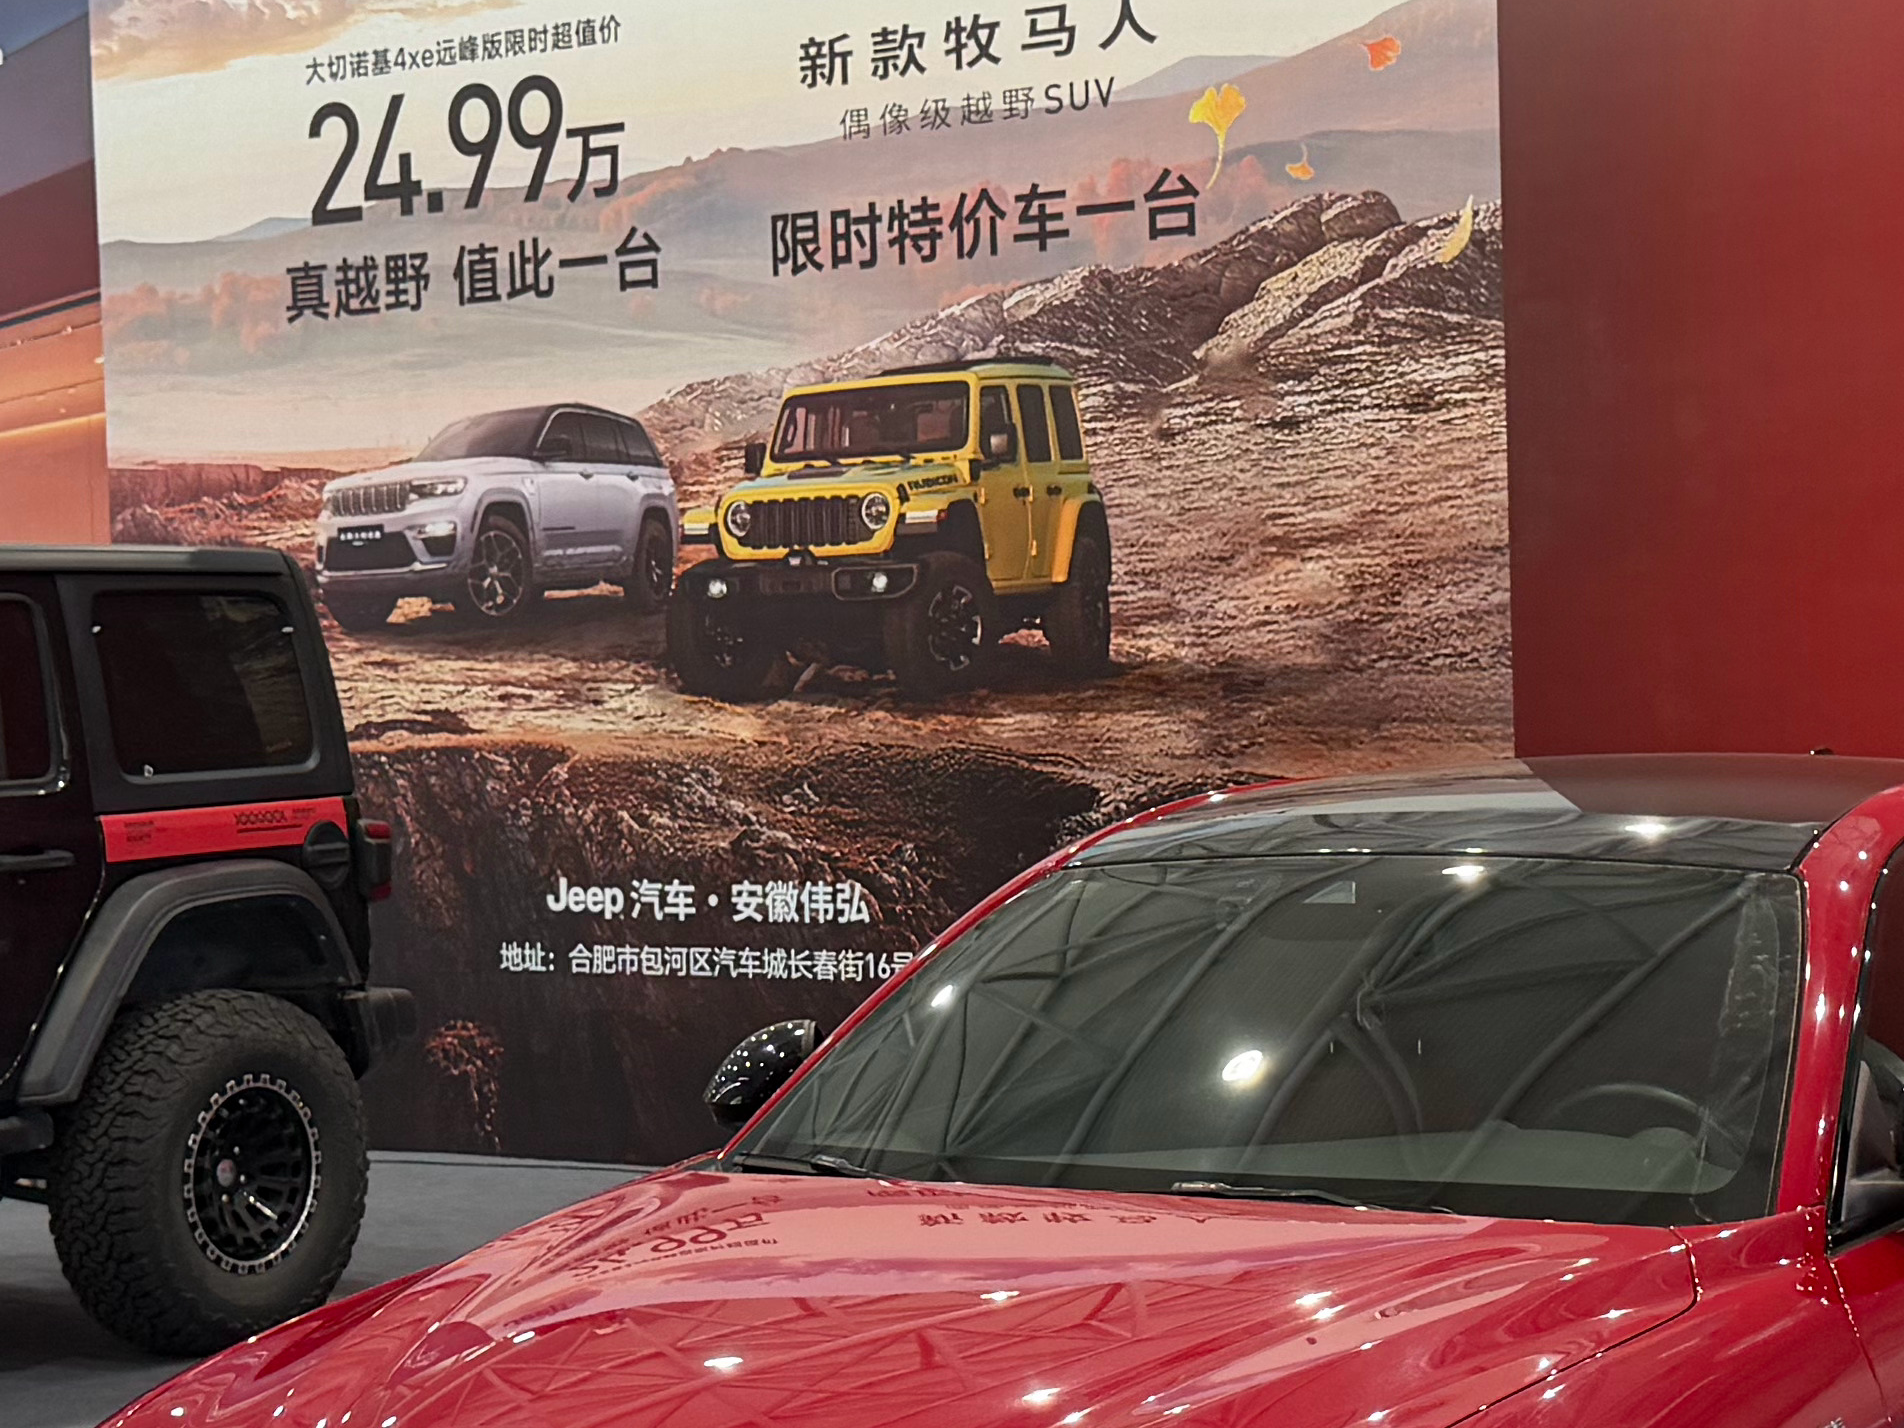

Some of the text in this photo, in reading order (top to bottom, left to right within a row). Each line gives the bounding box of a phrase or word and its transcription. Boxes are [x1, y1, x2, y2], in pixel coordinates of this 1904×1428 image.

[305, 13, 622, 85] 大切诺基4xe远峰版限时超值价
[307, 74, 626, 227] 24.99万
[839, 76, 1115, 141] 偶像级越野SUV
[770, 168, 1200, 278] 限时特价车一台
[284, 225, 662, 323] 真越野 值此一台
[545, 877, 626, 919] Jeep
